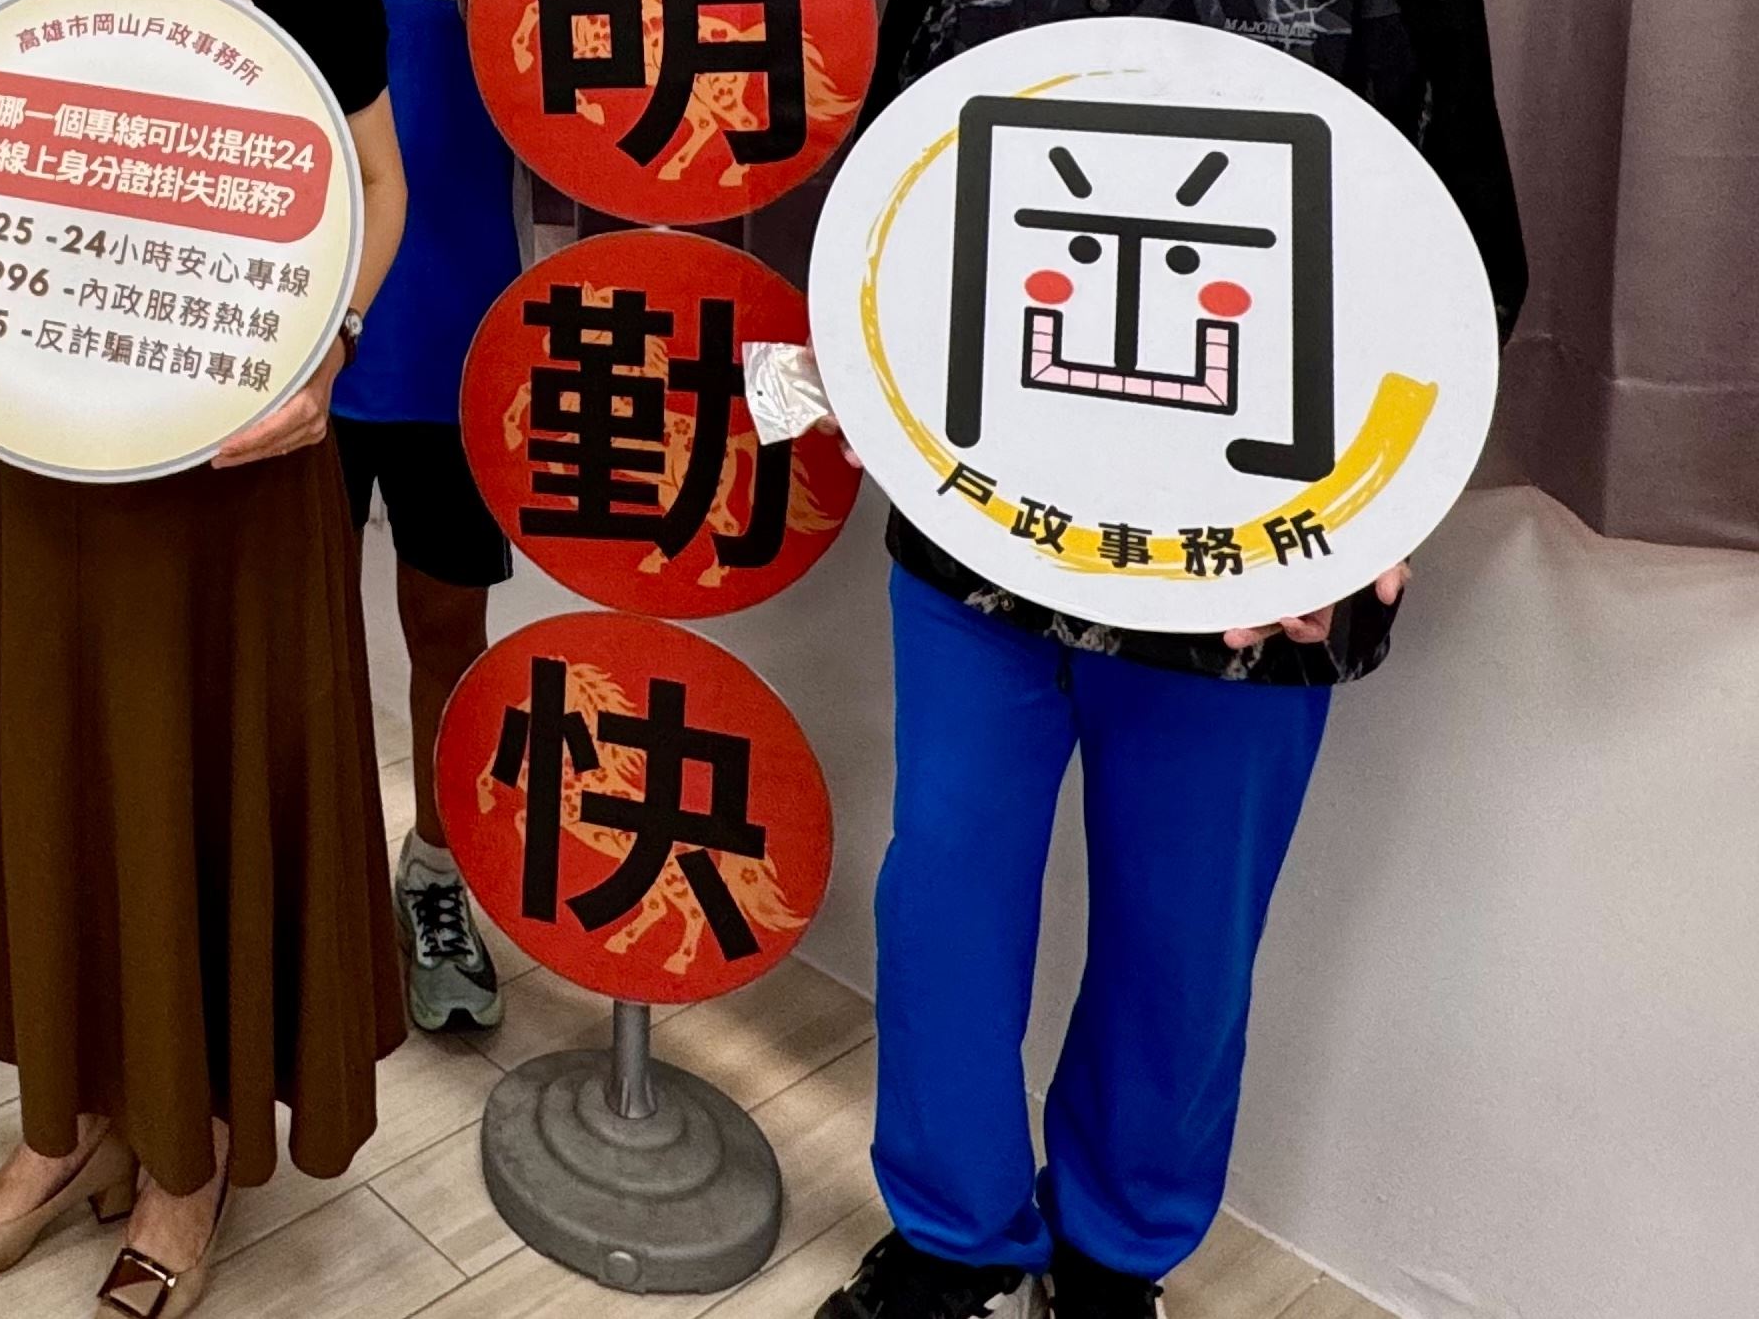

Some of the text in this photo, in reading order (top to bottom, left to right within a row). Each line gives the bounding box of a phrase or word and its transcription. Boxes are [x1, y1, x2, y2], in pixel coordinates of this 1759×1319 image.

[16, 13, 263, 86] 高雄市岡山戶政事務所
[937, 461, 1333, 576] 戶政事務所
